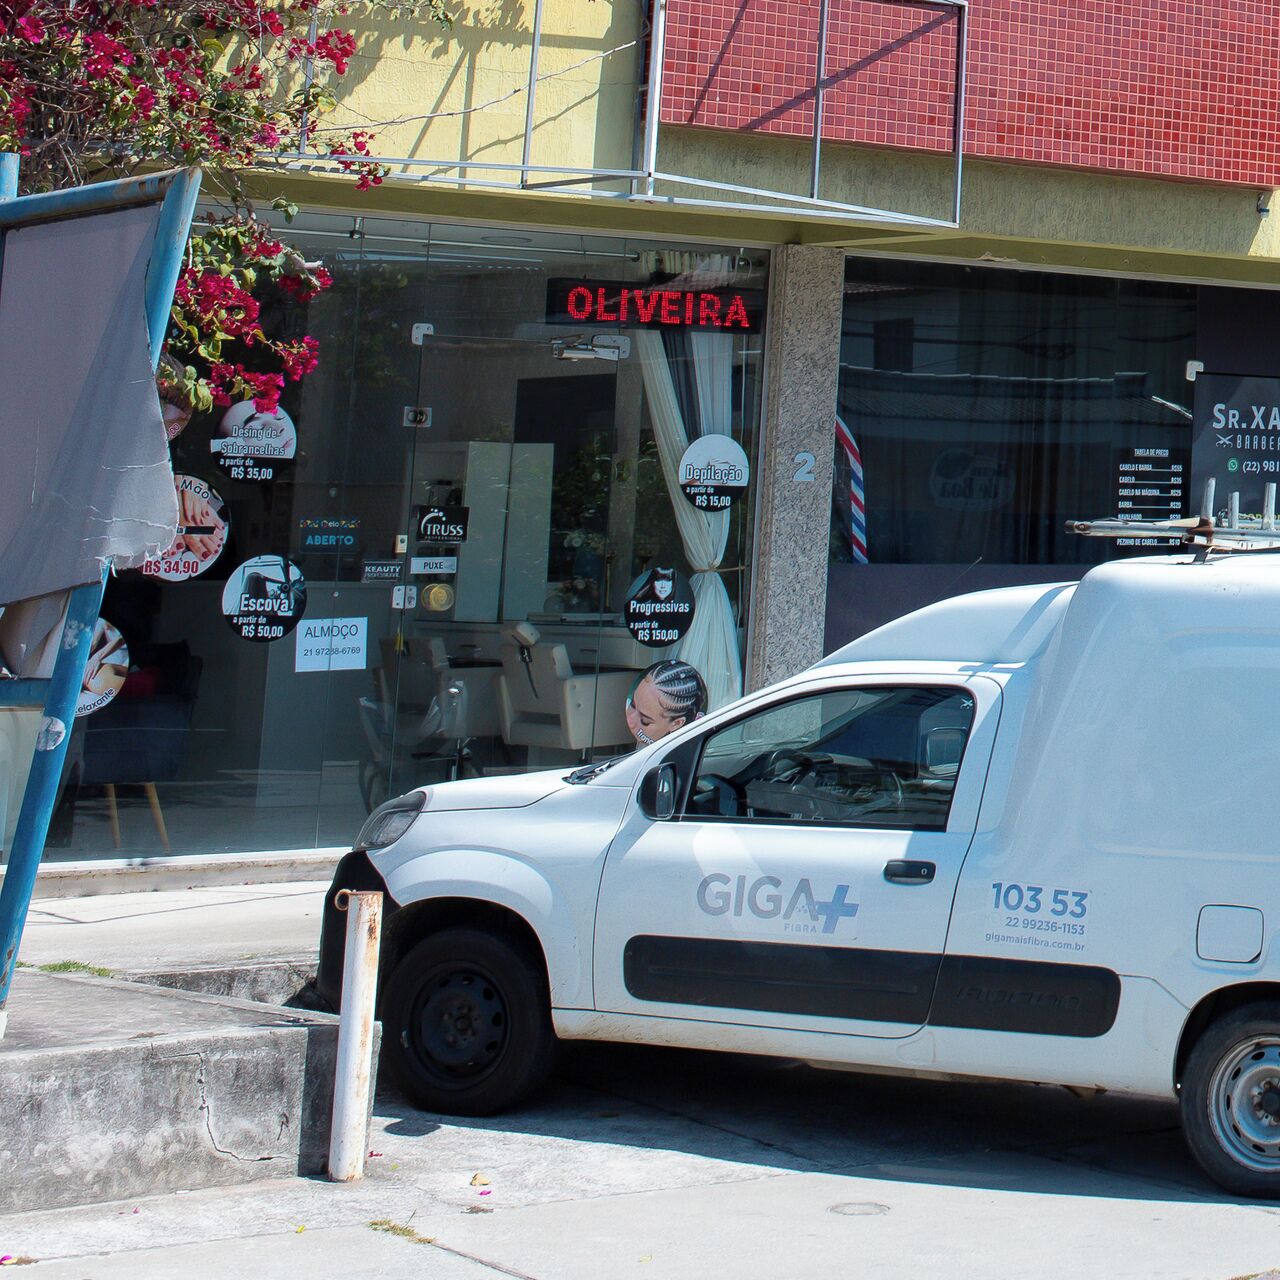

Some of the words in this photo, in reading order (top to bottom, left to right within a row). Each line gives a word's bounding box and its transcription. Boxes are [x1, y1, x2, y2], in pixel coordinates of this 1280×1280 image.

[567, 286, 750, 327] OLIVEIRA
[232, 425, 263, 441] Desing
[265, 427, 278, 439] de
[220, 442, 286, 456] Sobrancelhas
[1134, 448, 1150, 457] TABELA
[1150, 449, 1156, 457] DE
[225, 457, 244, 467] partir
[245, 458, 254, 466] de
[792, 451, 816, 482] 2
[1242, 461, 1260, 474] (22)
[231, 467, 244, 480] R$
[246, 467, 273, 480] 35,00
[685, 463, 743, 485] Depilação
[1119, 476, 1136, 484] CABELO
[179, 478, 211, 500] Mão
[690, 486, 706, 494] partir
[1119, 488, 1134, 496] CABELO
[1141, 488, 1160, 496] MÁQUINA
[695, 495, 708, 507] R$
[709, 495, 731, 508] 15,00
[426, 524, 464, 536] TRUSS
[306, 535, 354, 546] ABERTO
[1142, 538, 1157, 546] CABELO
[164, 560, 199, 574] 34,90
[424, 561, 444, 570] PUXE
[240, 594, 289, 612] Escova
[630, 600, 690, 616] Progressivas
[238, 616, 257, 625] partir
[258, 616, 267, 624] de
[242, 626, 254, 638] R$
[257, 626, 284, 638] 50,00
[304, 624, 358, 640] ALMOÇO
[638, 630, 649, 641] R$
[652, 629, 679, 641] 150,00
[304, 648, 313, 656] 21
[75, 688, 116, 714] elaxante
[992, 882, 1043, 914] 103
[1050, 890, 1088, 918] 53
[784, 923, 817, 934] FIBRA
[1005, 916, 1019, 928] 22
[1021, 918, 1086, 936] 99236-1153
[985, 932, 1086, 952] gigamaisfibra.com.br
